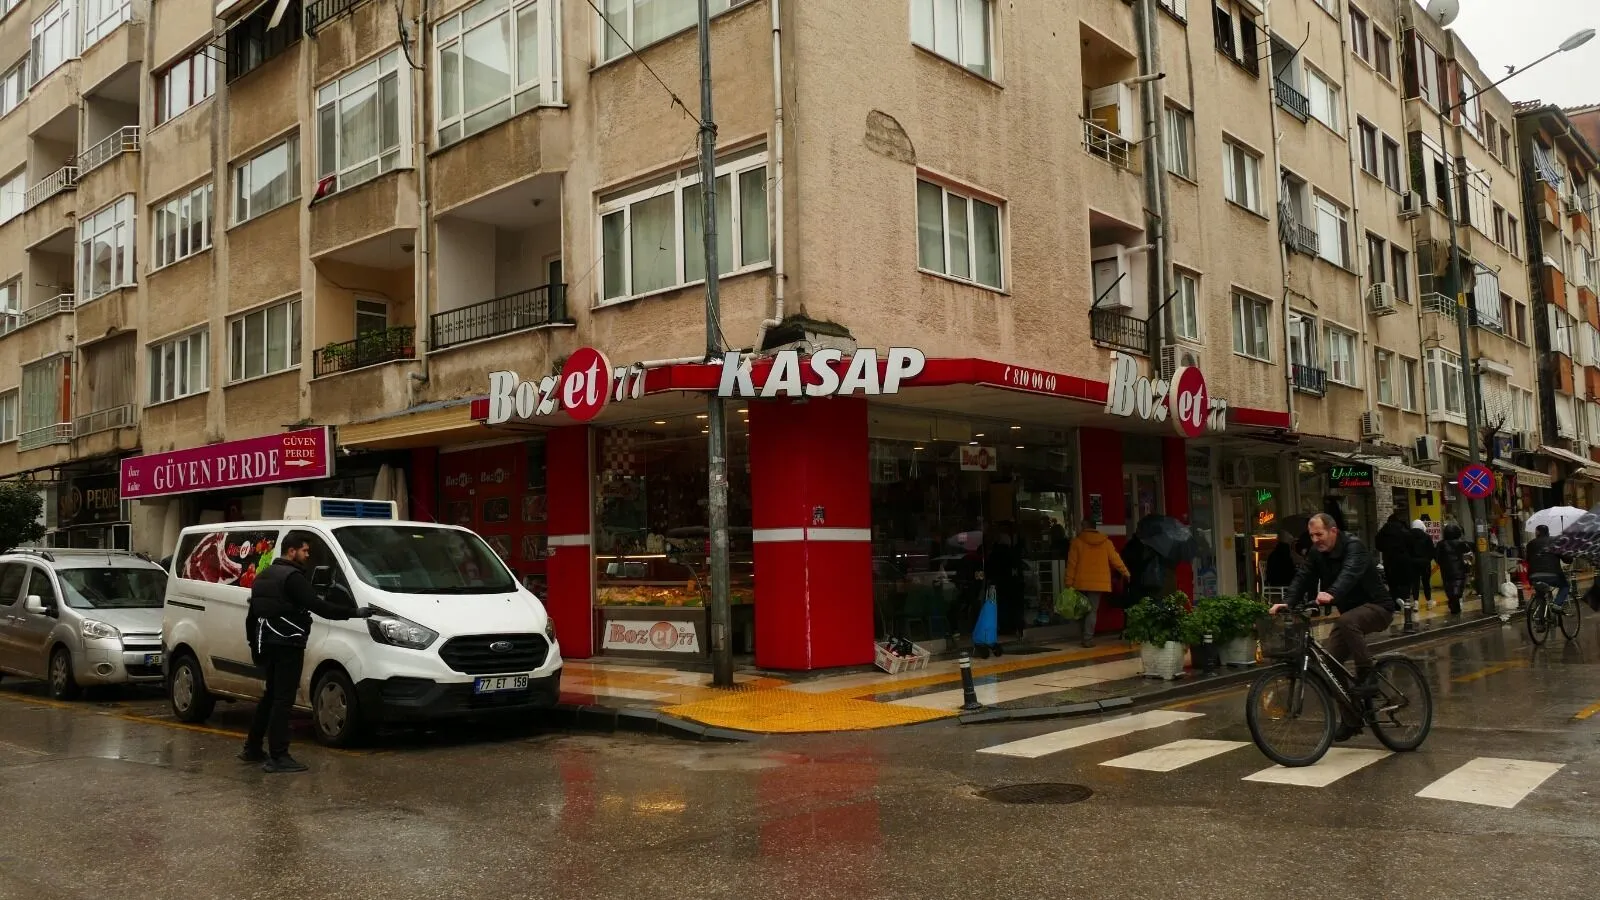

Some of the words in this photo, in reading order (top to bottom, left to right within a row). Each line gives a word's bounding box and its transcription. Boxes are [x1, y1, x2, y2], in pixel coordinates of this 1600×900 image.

[717, 347, 925, 397] KASAP
[1013, 368, 1029, 386] 810
[1032, 372, 1043, 389] 00
[1045, 374, 1057, 391] 60
[613, 365, 646, 401] 77
[283, 437, 316, 446] GÜVEN
[285, 449, 315, 458] PERDE
[153, 458, 213, 490] GÜVEN
[216, 449, 280, 482] PERDE
[679, 632, 695, 646] 77
[480, 679, 491, 690] 77
[496, 678, 507, 689] ET
[513, 677, 527, 688] 158
